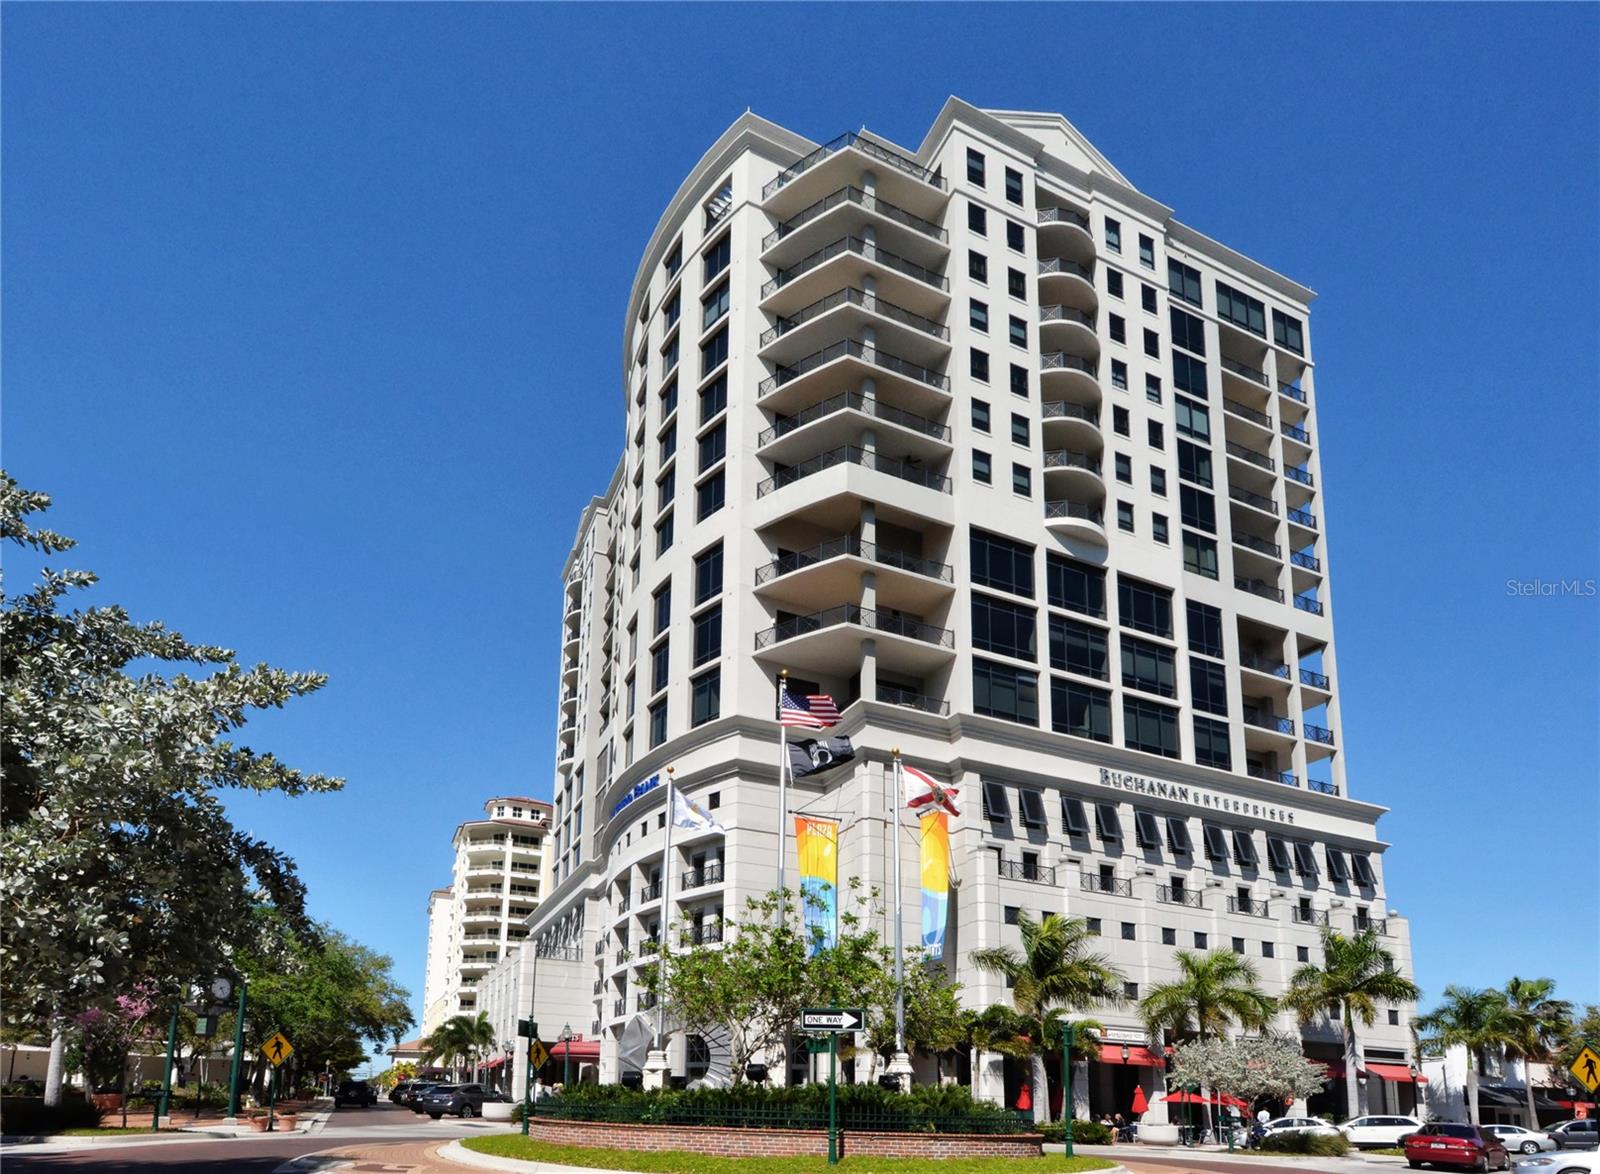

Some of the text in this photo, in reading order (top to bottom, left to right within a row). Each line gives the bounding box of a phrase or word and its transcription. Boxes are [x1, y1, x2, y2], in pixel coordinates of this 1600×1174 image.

[1099, 768, 1188, 802] BUCHANAN
[807, 1016, 843, 1024] ONE WAY
